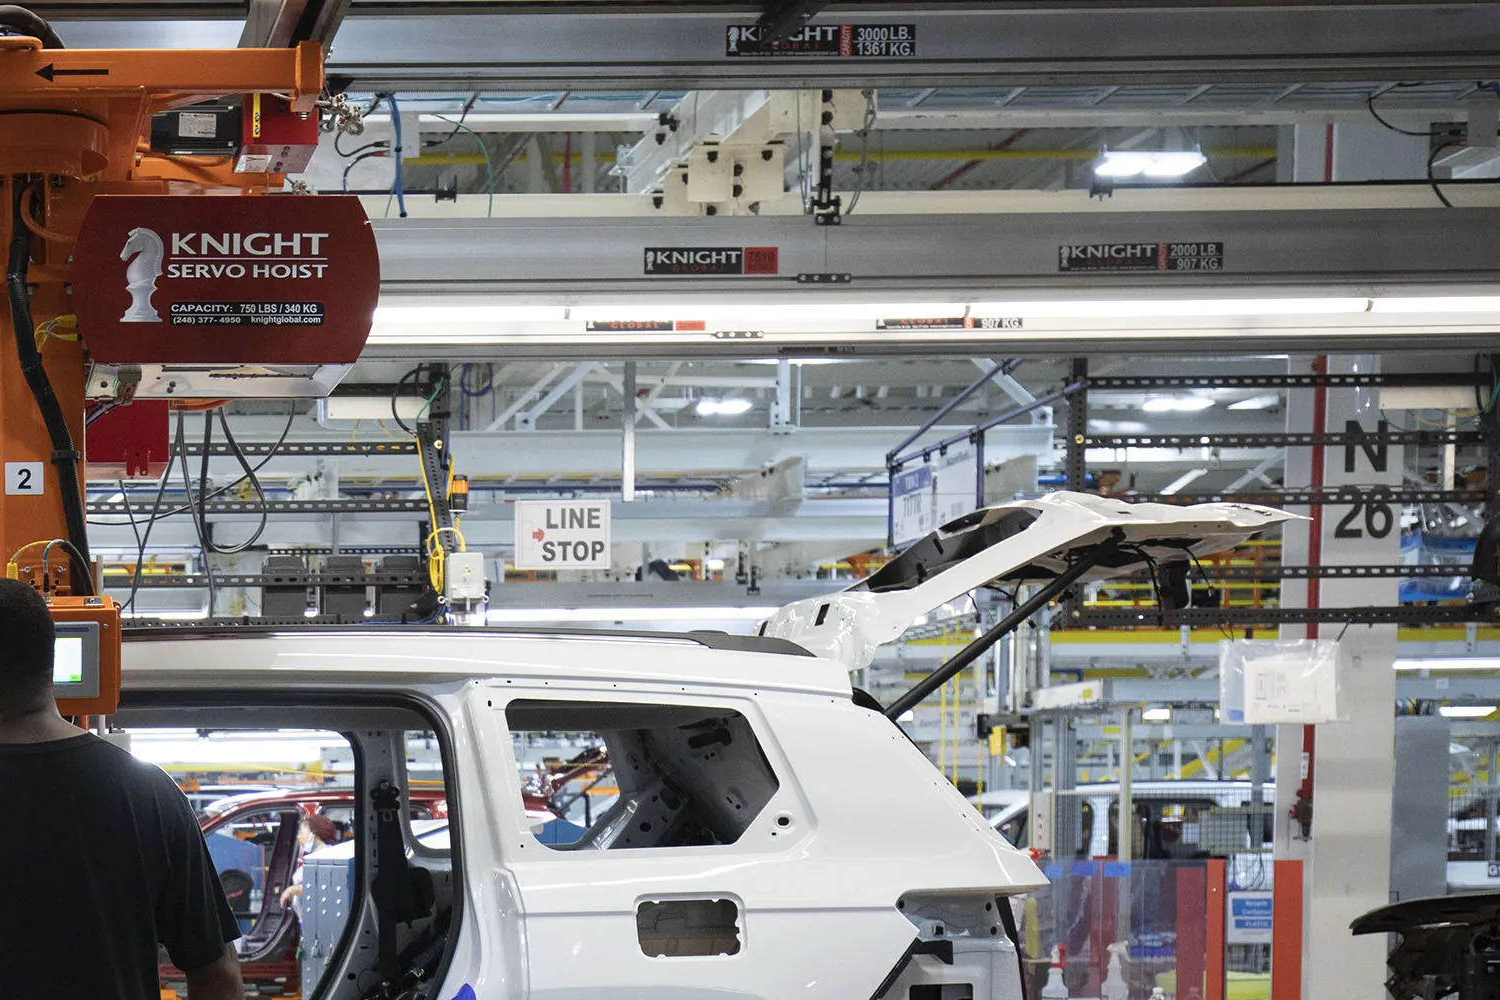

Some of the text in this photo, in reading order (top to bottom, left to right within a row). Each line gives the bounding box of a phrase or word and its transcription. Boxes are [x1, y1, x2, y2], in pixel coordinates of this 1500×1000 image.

[857, 26, 912, 41] 3000 LB.
[857, 42, 914, 56] 1361 KG.
[171, 232, 329, 256] KNIGHT
[1170, 244, 1220, 257] 2000 LB.
[656, 251, 742, 264] KNIGHT
[1071, 245, 1156, 259] KNIGHT
[167, 263, 329, 279] SERVO HOIST
[1176, 258, 1222, 270] 907 KG.
[171, 304, 233, 314] CAPACITY:
[240, 304, 256, 314] 750
[258, 304, 277, 314] LBS
[284, 304, 301, 314] 340
[302, 304, 318, 314] KG
[173, 316, 196, 325] (248)
[219, 316, 241, 325] 4950
[250, 315, 321, 326] knightglobal.com
[1344, 420, 1388, 473] N
[17, 468, 32, 490] 2
[545, 508, 601, 530] LINE
[1334, 484, 1394, 540] 26
[541, 540, 606, 562] STOP
